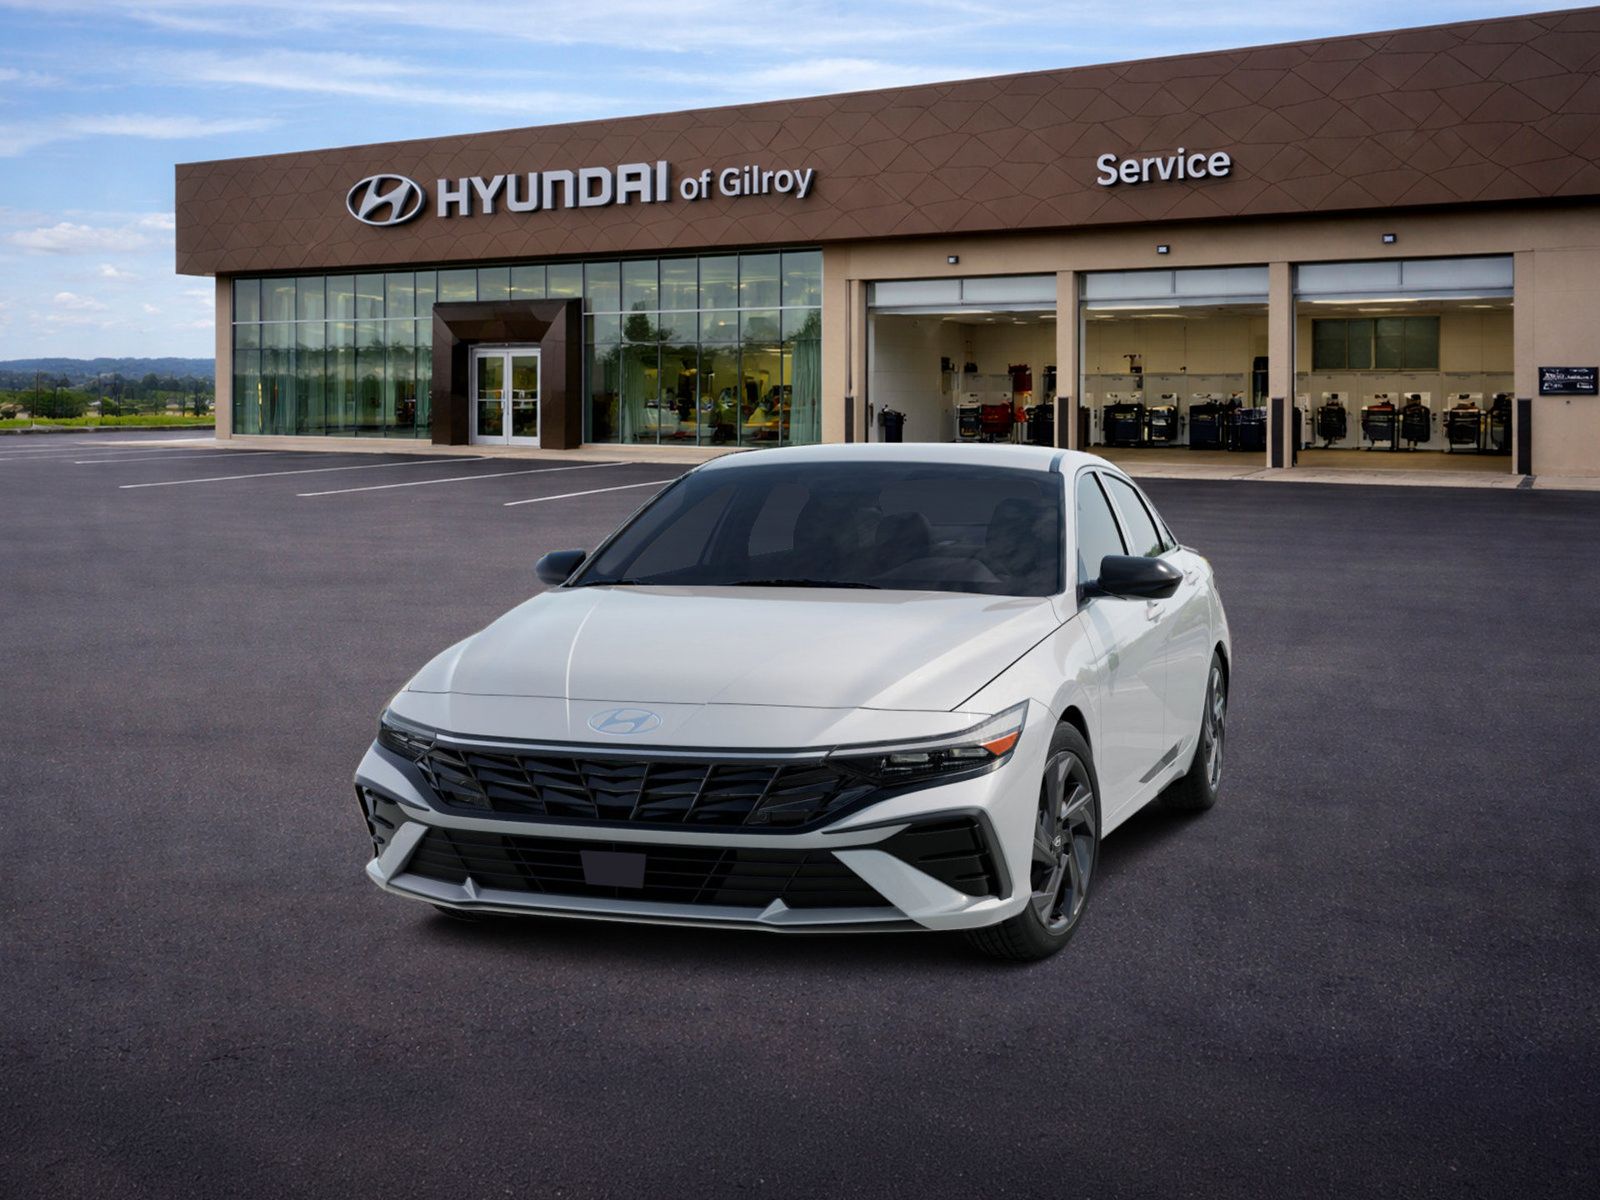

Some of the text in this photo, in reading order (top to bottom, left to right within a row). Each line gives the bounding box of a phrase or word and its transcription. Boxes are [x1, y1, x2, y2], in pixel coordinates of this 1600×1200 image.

[437, 160, 815, 218] HYUNDAI of Gilroy
[1096, 147, 1231, 186] Service
